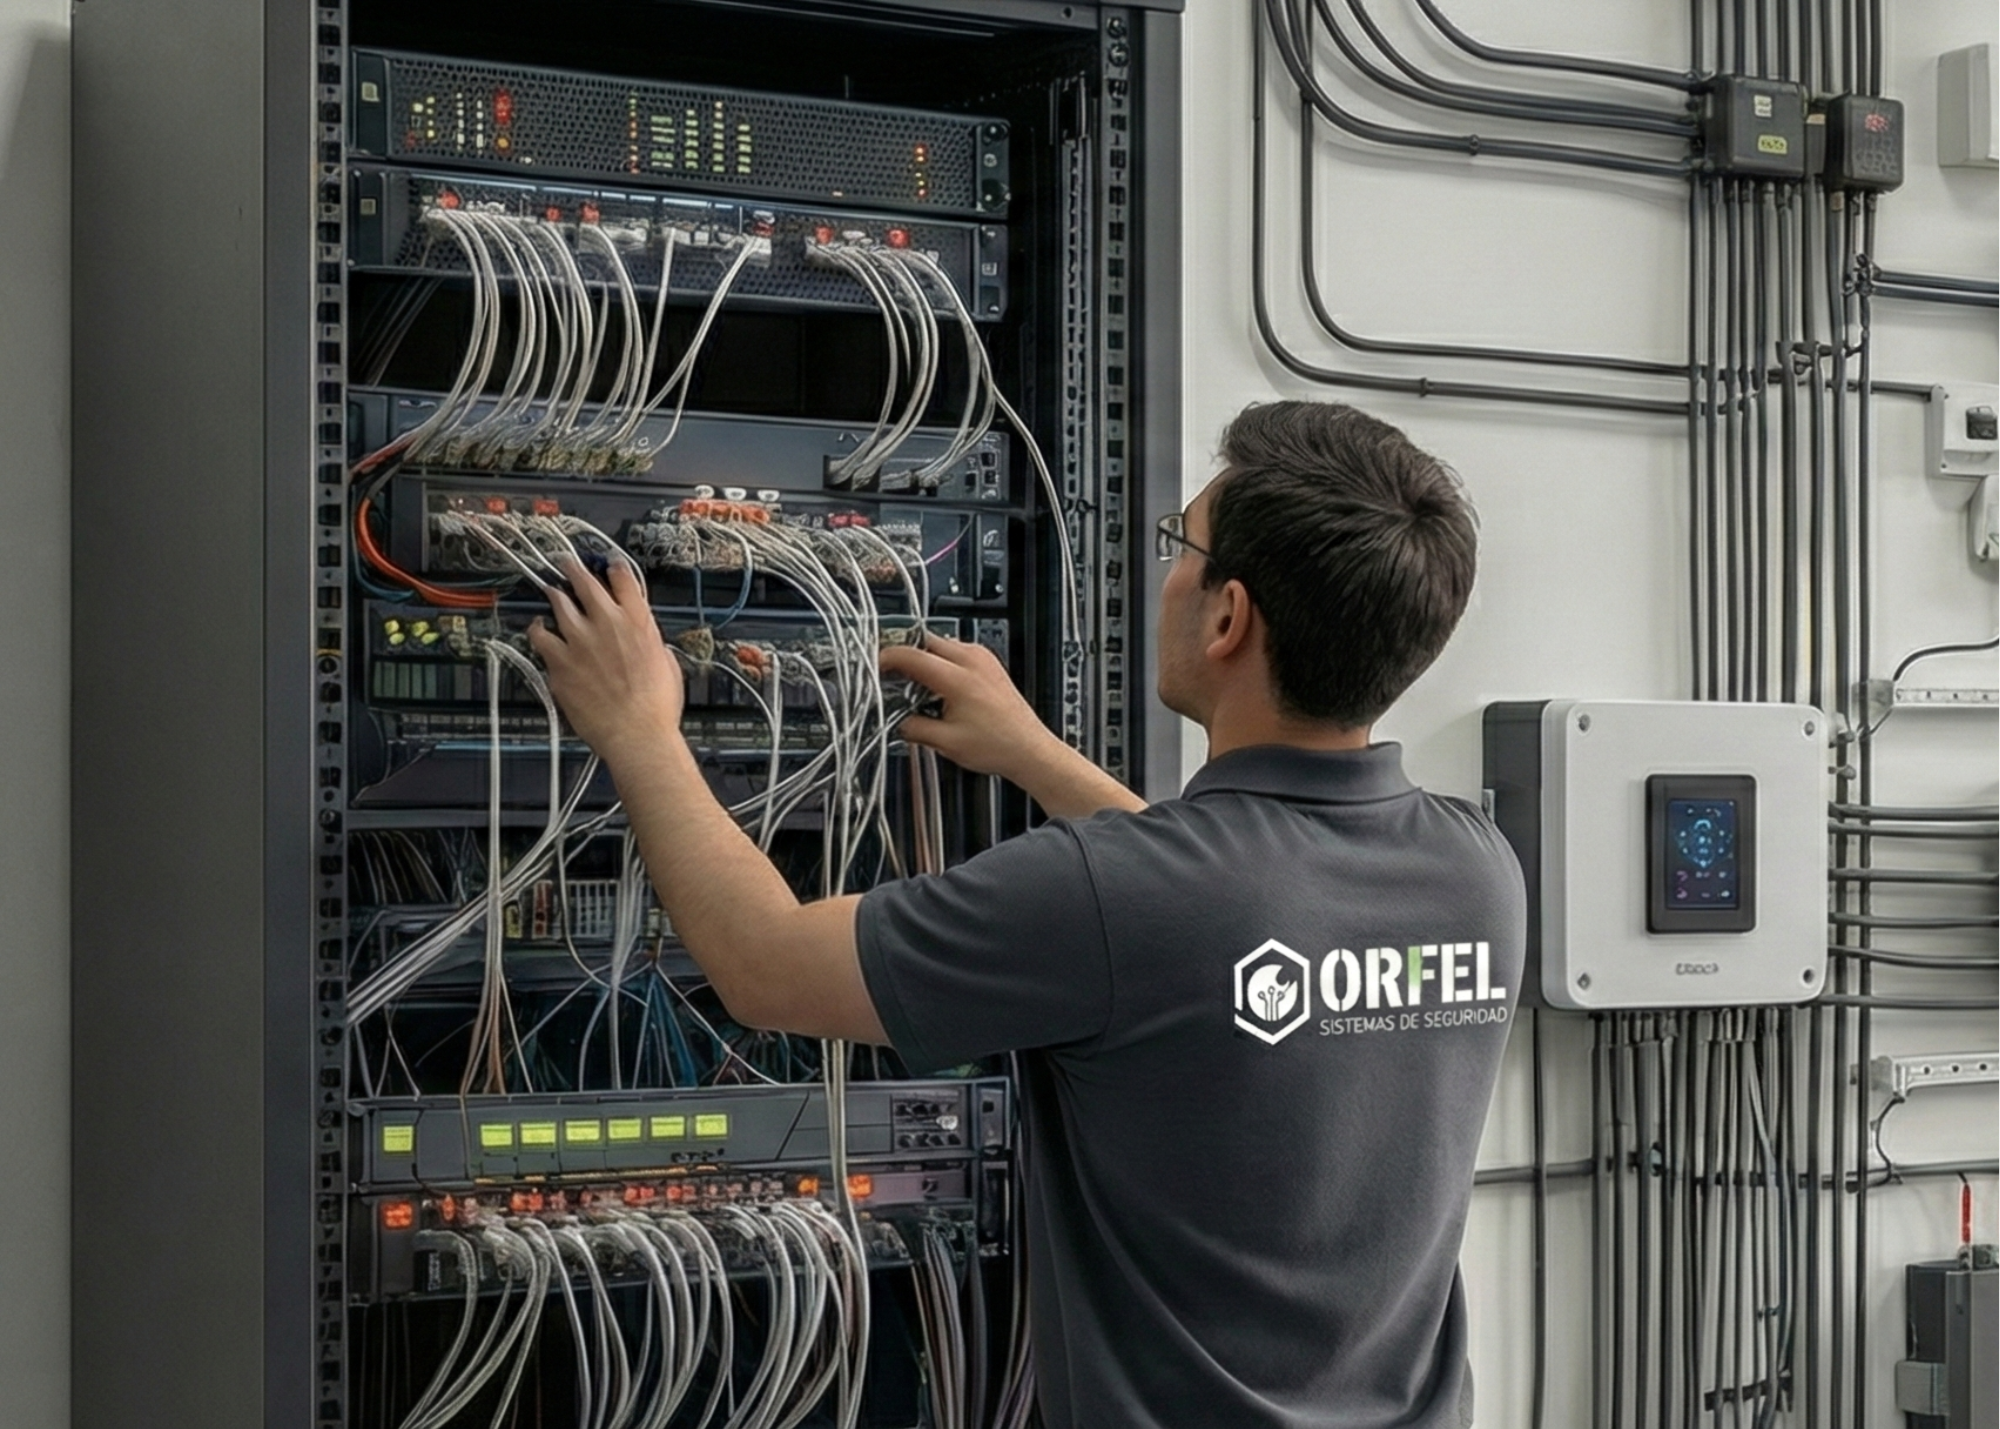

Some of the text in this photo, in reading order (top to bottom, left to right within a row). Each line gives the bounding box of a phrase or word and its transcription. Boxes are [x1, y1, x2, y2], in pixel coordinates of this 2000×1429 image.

[1319, 941, 1507, 1012] ORFEL
[1319, 1006, 1508, 1036] SISTEMAS DE SEGURIDAD
